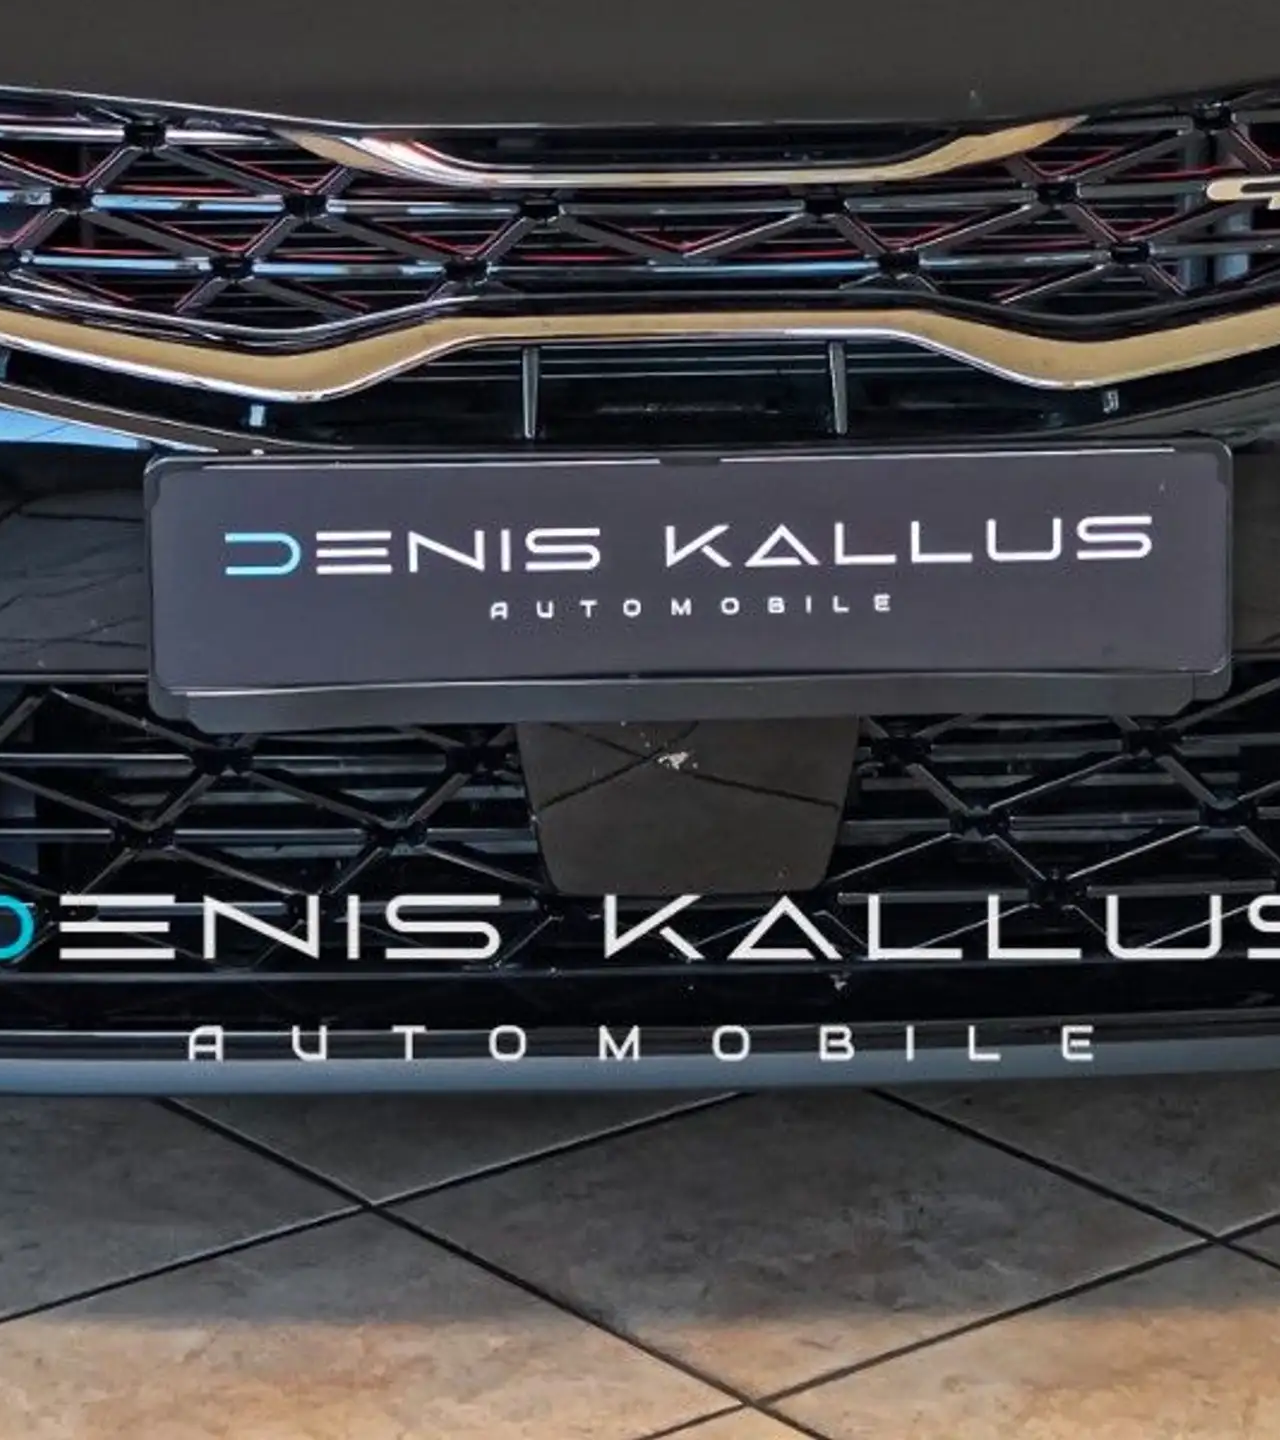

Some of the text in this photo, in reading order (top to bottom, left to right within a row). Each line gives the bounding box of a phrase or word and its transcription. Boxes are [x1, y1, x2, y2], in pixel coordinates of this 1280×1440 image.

[224, 514, 1153, 576] DENIS KALLUS
[489, 592, 893, 621] AUTOMOBILE
